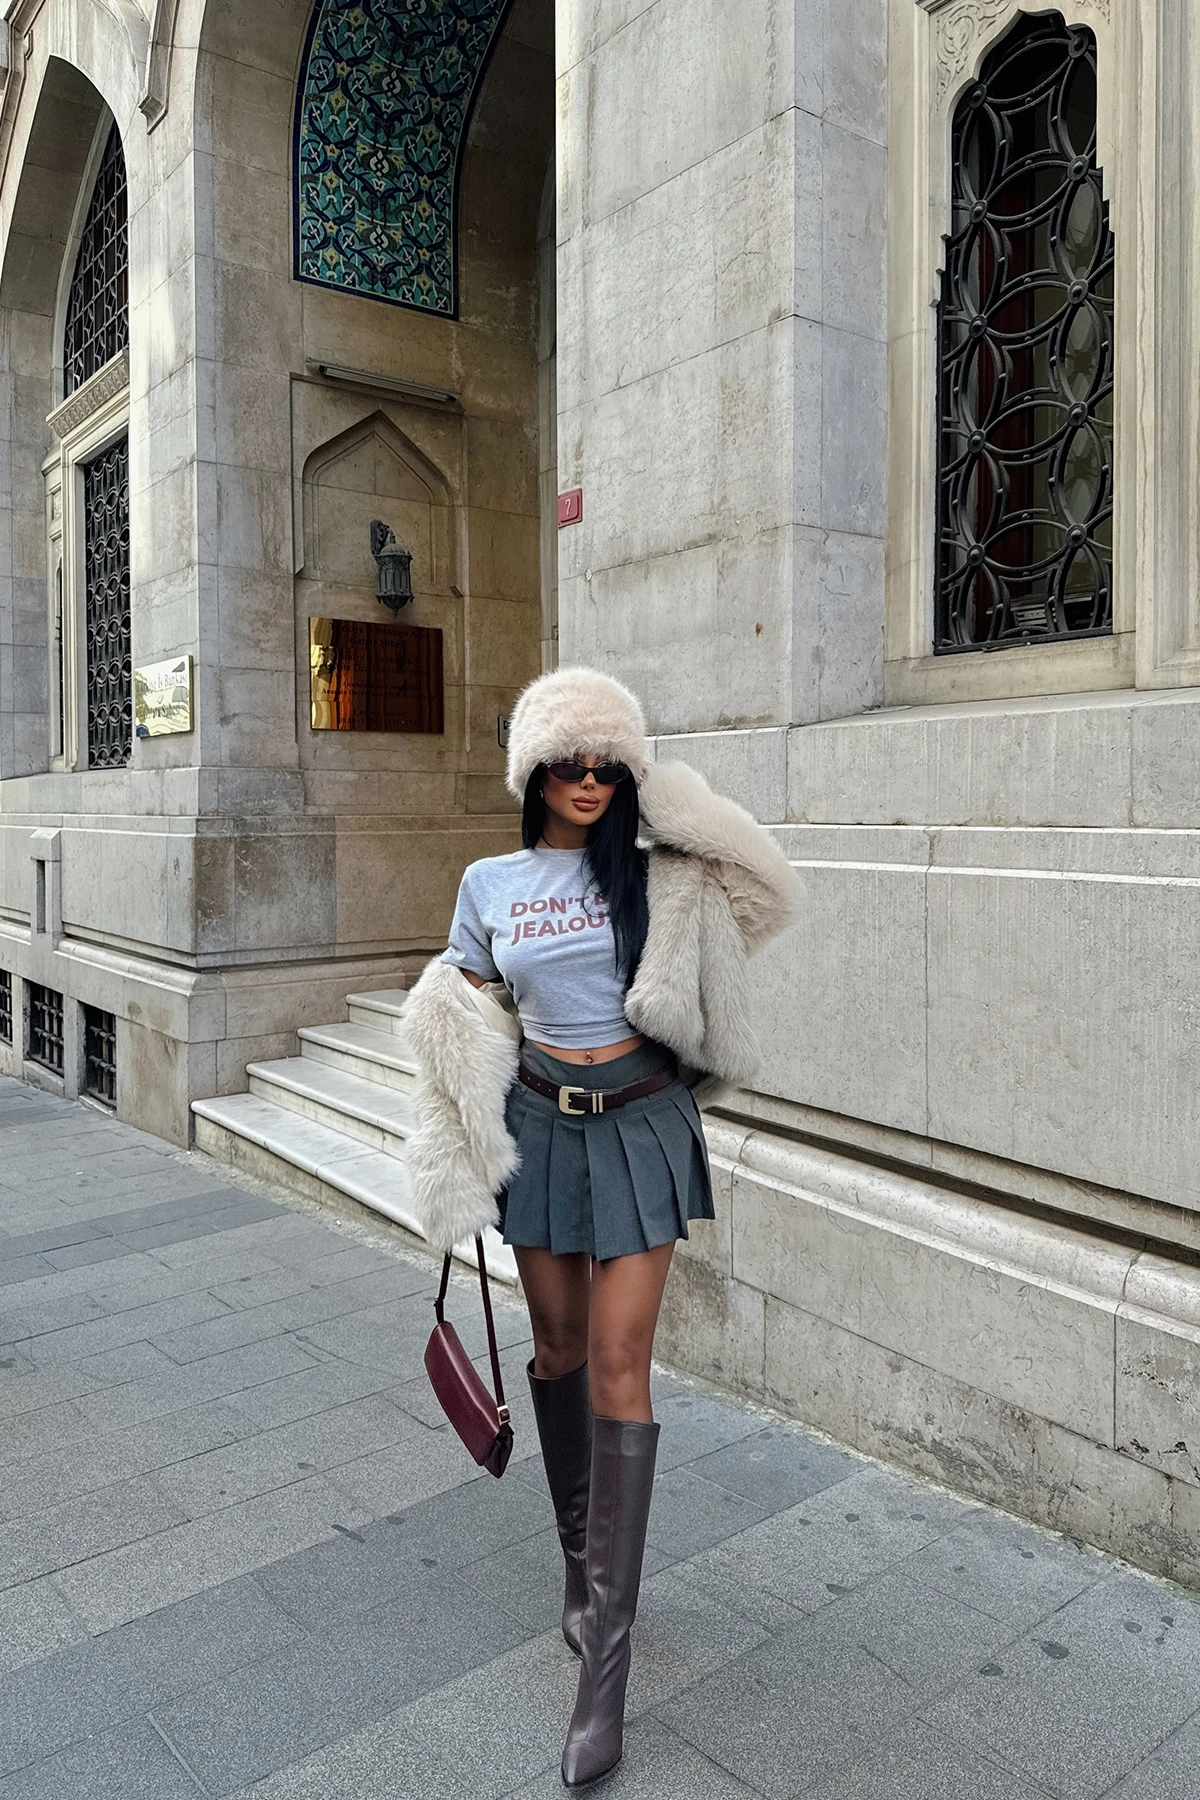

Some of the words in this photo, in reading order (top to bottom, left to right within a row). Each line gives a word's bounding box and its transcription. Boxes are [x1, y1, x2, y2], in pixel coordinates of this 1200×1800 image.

[565, 498, 571, 517] 7
[510, 896, 589, 918] DON'T
[511, 912, 606, 946] JEALOU
